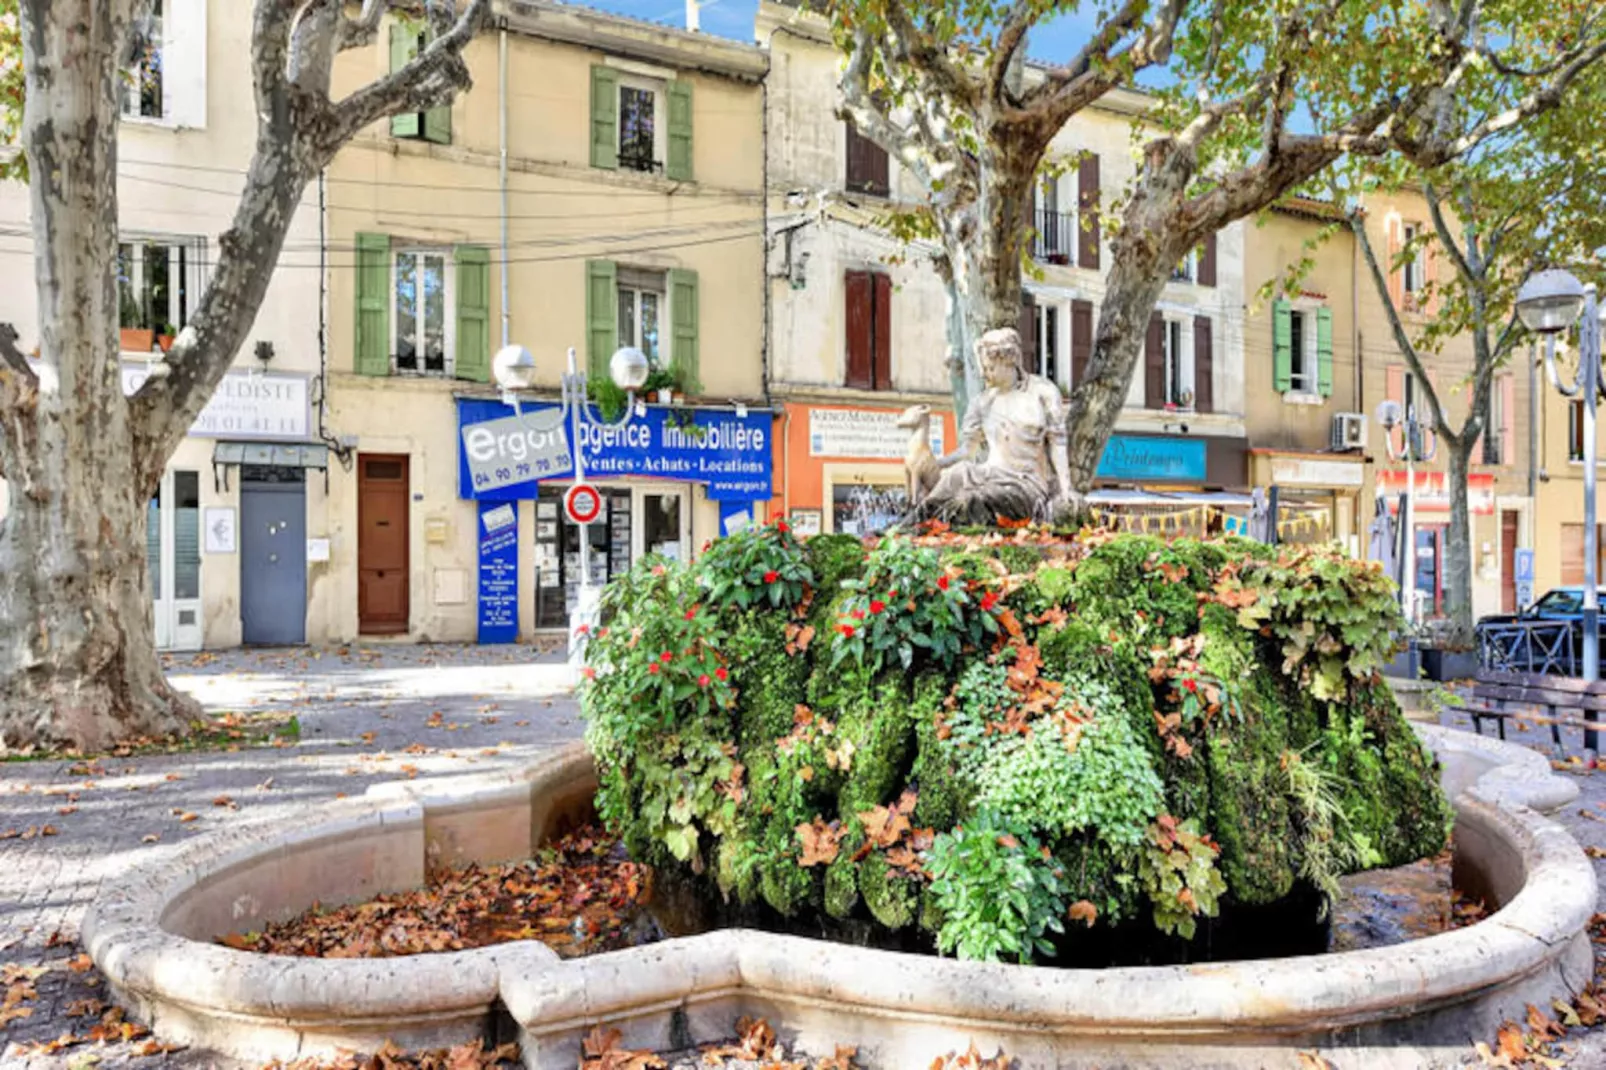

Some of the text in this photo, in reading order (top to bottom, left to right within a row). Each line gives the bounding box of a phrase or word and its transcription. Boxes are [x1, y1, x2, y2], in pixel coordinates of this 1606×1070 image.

[467, 427, 565, 460] ergon
[579, 420, 765, 454] agence immobilière
[475, 472, 490, 486] 04
[495, 466, 511, 480] 90
[516, 461, 531, 475] 79
[699, 457, 764, 474] Locations
